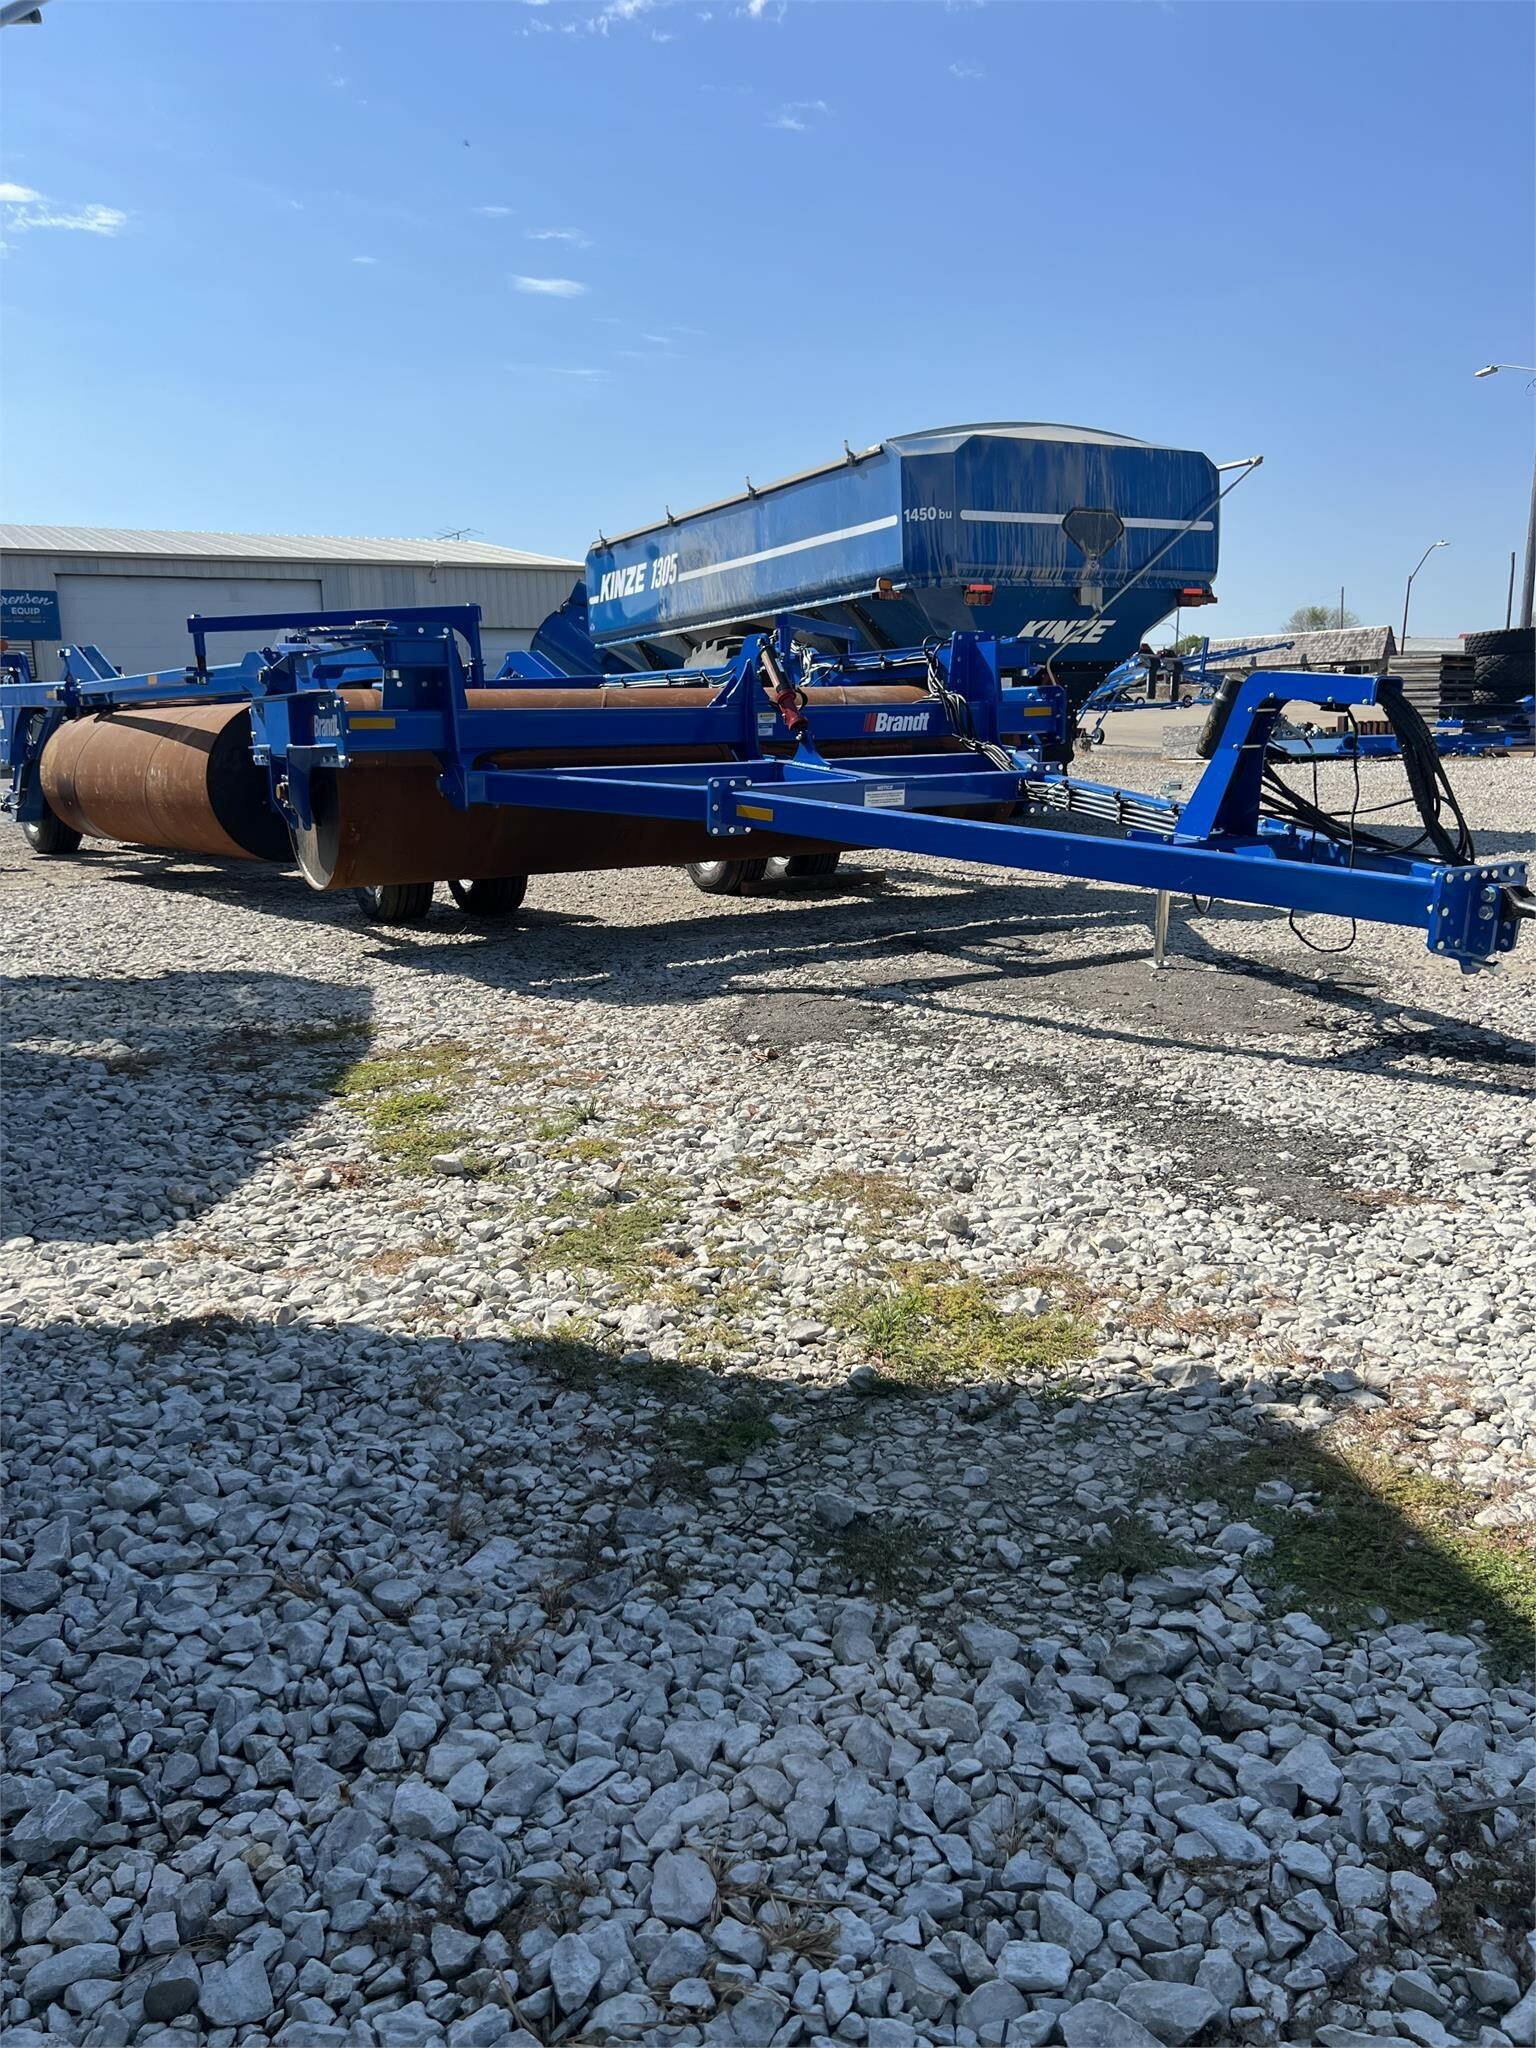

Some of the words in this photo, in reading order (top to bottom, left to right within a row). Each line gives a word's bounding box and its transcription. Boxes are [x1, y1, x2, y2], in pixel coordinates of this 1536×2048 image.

[903, 506, 937, 522] 1450
[938, 508, 952, 520] bu
[600, 562, 647, 602] KINZE
[650, 552, 678, 589] 1305
[11, 606, 41, 615] EQUIP
[1018, 620, 1116, 643] KINZE
[875, 712, 930, 732] Brandt
